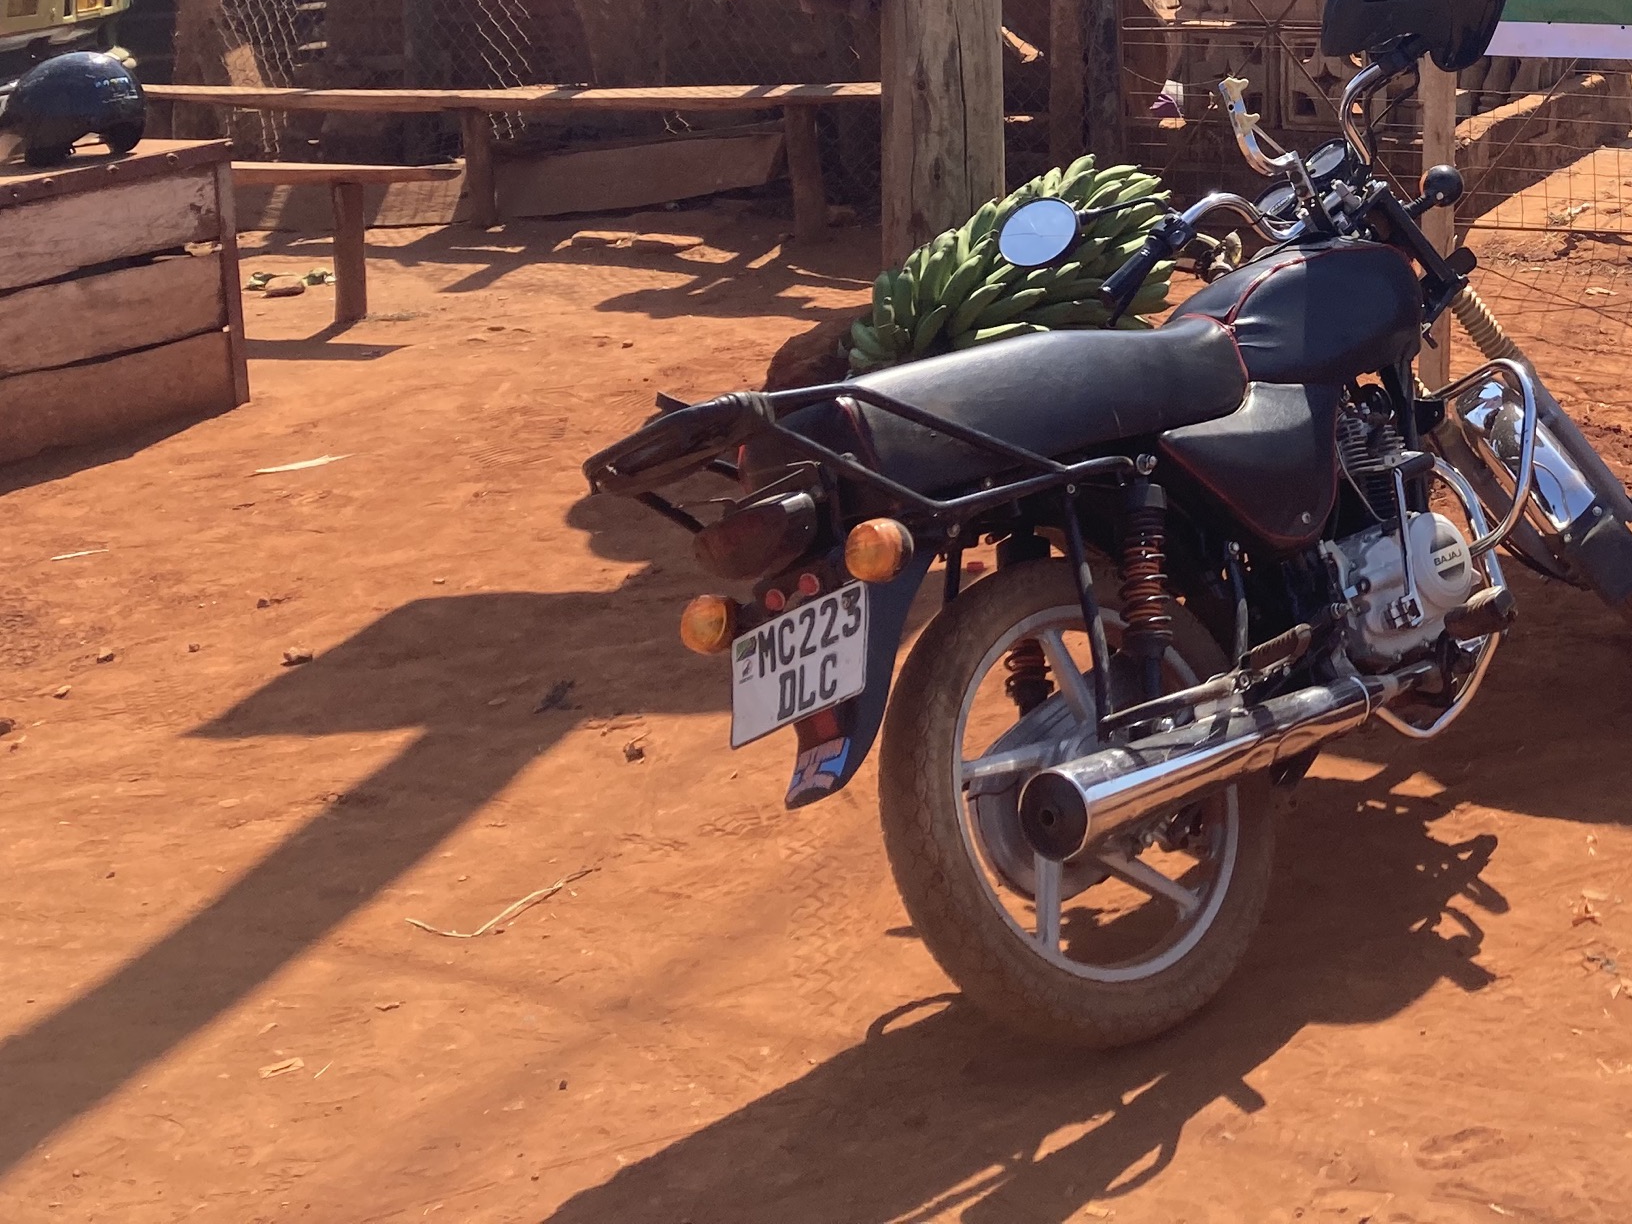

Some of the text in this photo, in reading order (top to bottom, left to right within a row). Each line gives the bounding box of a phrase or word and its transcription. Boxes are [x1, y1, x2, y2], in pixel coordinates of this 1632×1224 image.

[1434, 549, 1462, 567] BAJAJ
[758, 586, 862, 678] MC223
[777, 653, 838, 722] DLC
